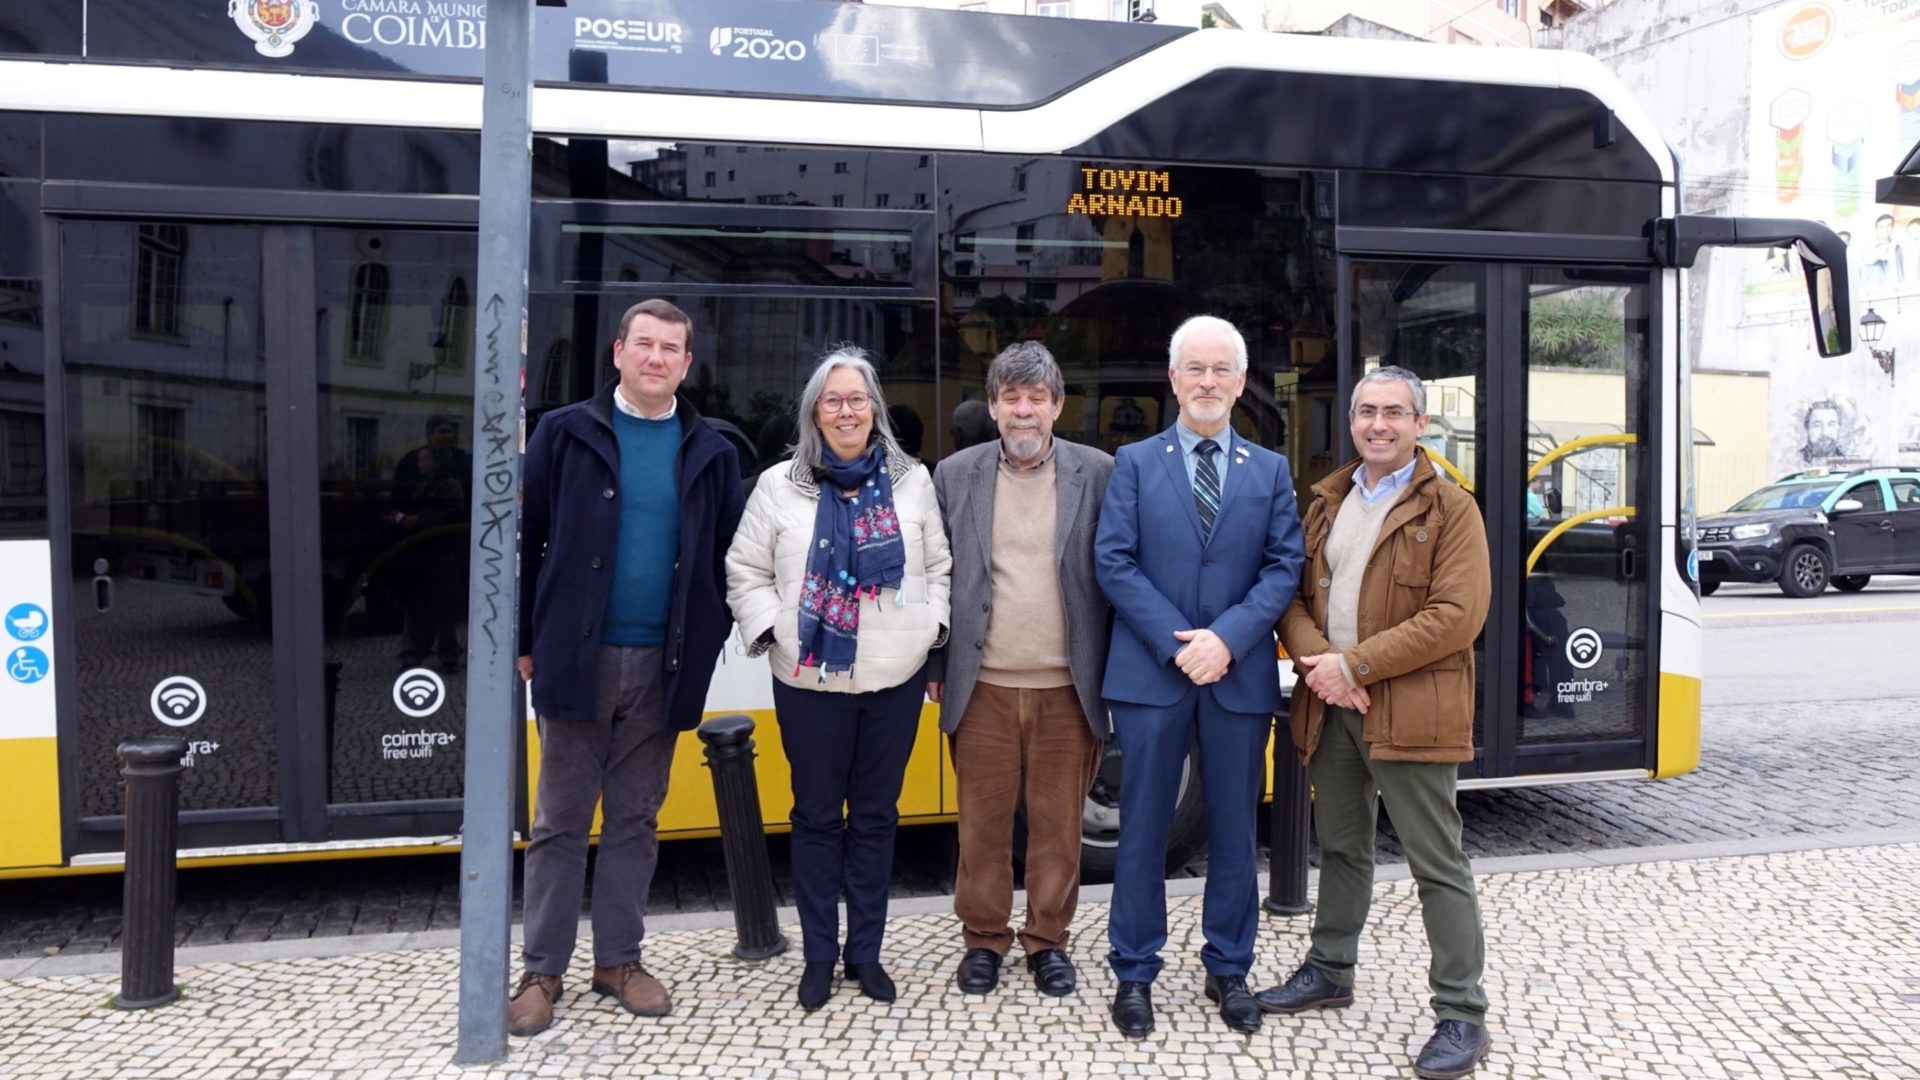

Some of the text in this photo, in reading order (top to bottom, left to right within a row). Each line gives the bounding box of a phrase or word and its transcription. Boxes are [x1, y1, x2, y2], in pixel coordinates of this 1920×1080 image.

[575, 17, 682, 43] POSEUR
[734, 27, 774, 37] PORTUGAL
[733, 37, 806, 61] 2020
[1081, 168, 1169, 192] TOVIM
[1067, 193, 1182, 218] ARNADO
[1557, 678, 1608, 692] coimbra+
[1557, 692, 1592, 704] free wifi
[381, 729, 456, 747] coimbra+
[382, 745, 432, 760] free wifi
